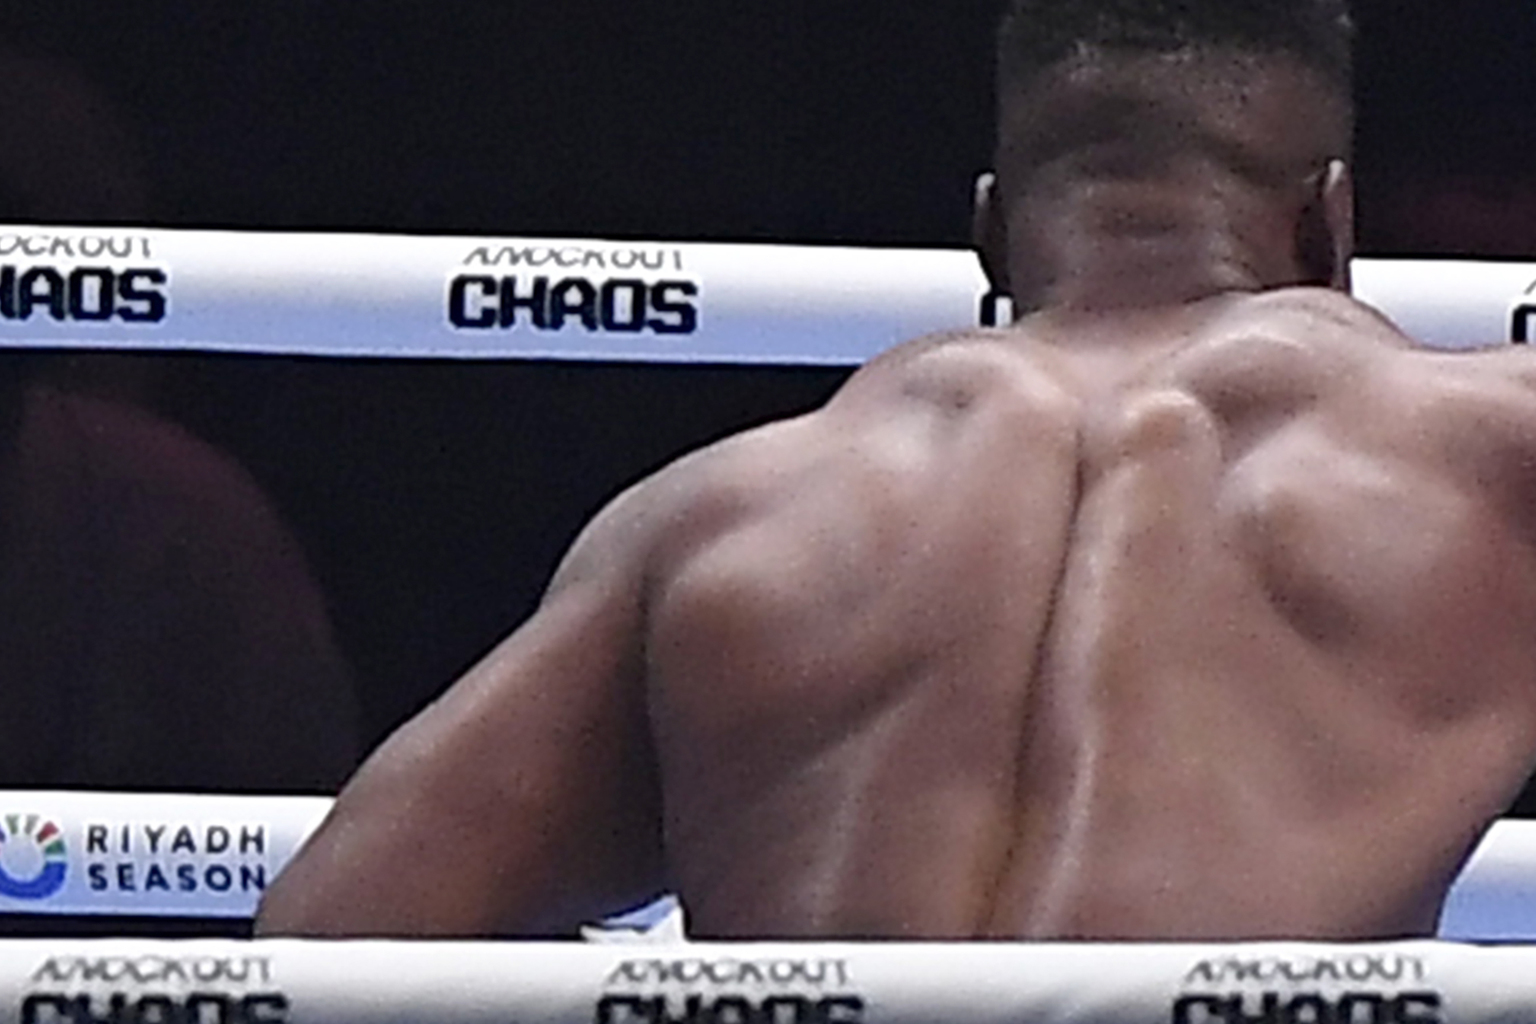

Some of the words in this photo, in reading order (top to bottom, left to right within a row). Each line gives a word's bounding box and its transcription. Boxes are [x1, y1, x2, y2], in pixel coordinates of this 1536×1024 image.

[0, 264, 167, 322] AOS
[449, 274, 698, 334] CHAOS
[86, 824, 265, 854] RIYADH
[87, 862, 266, 892] SEASON
